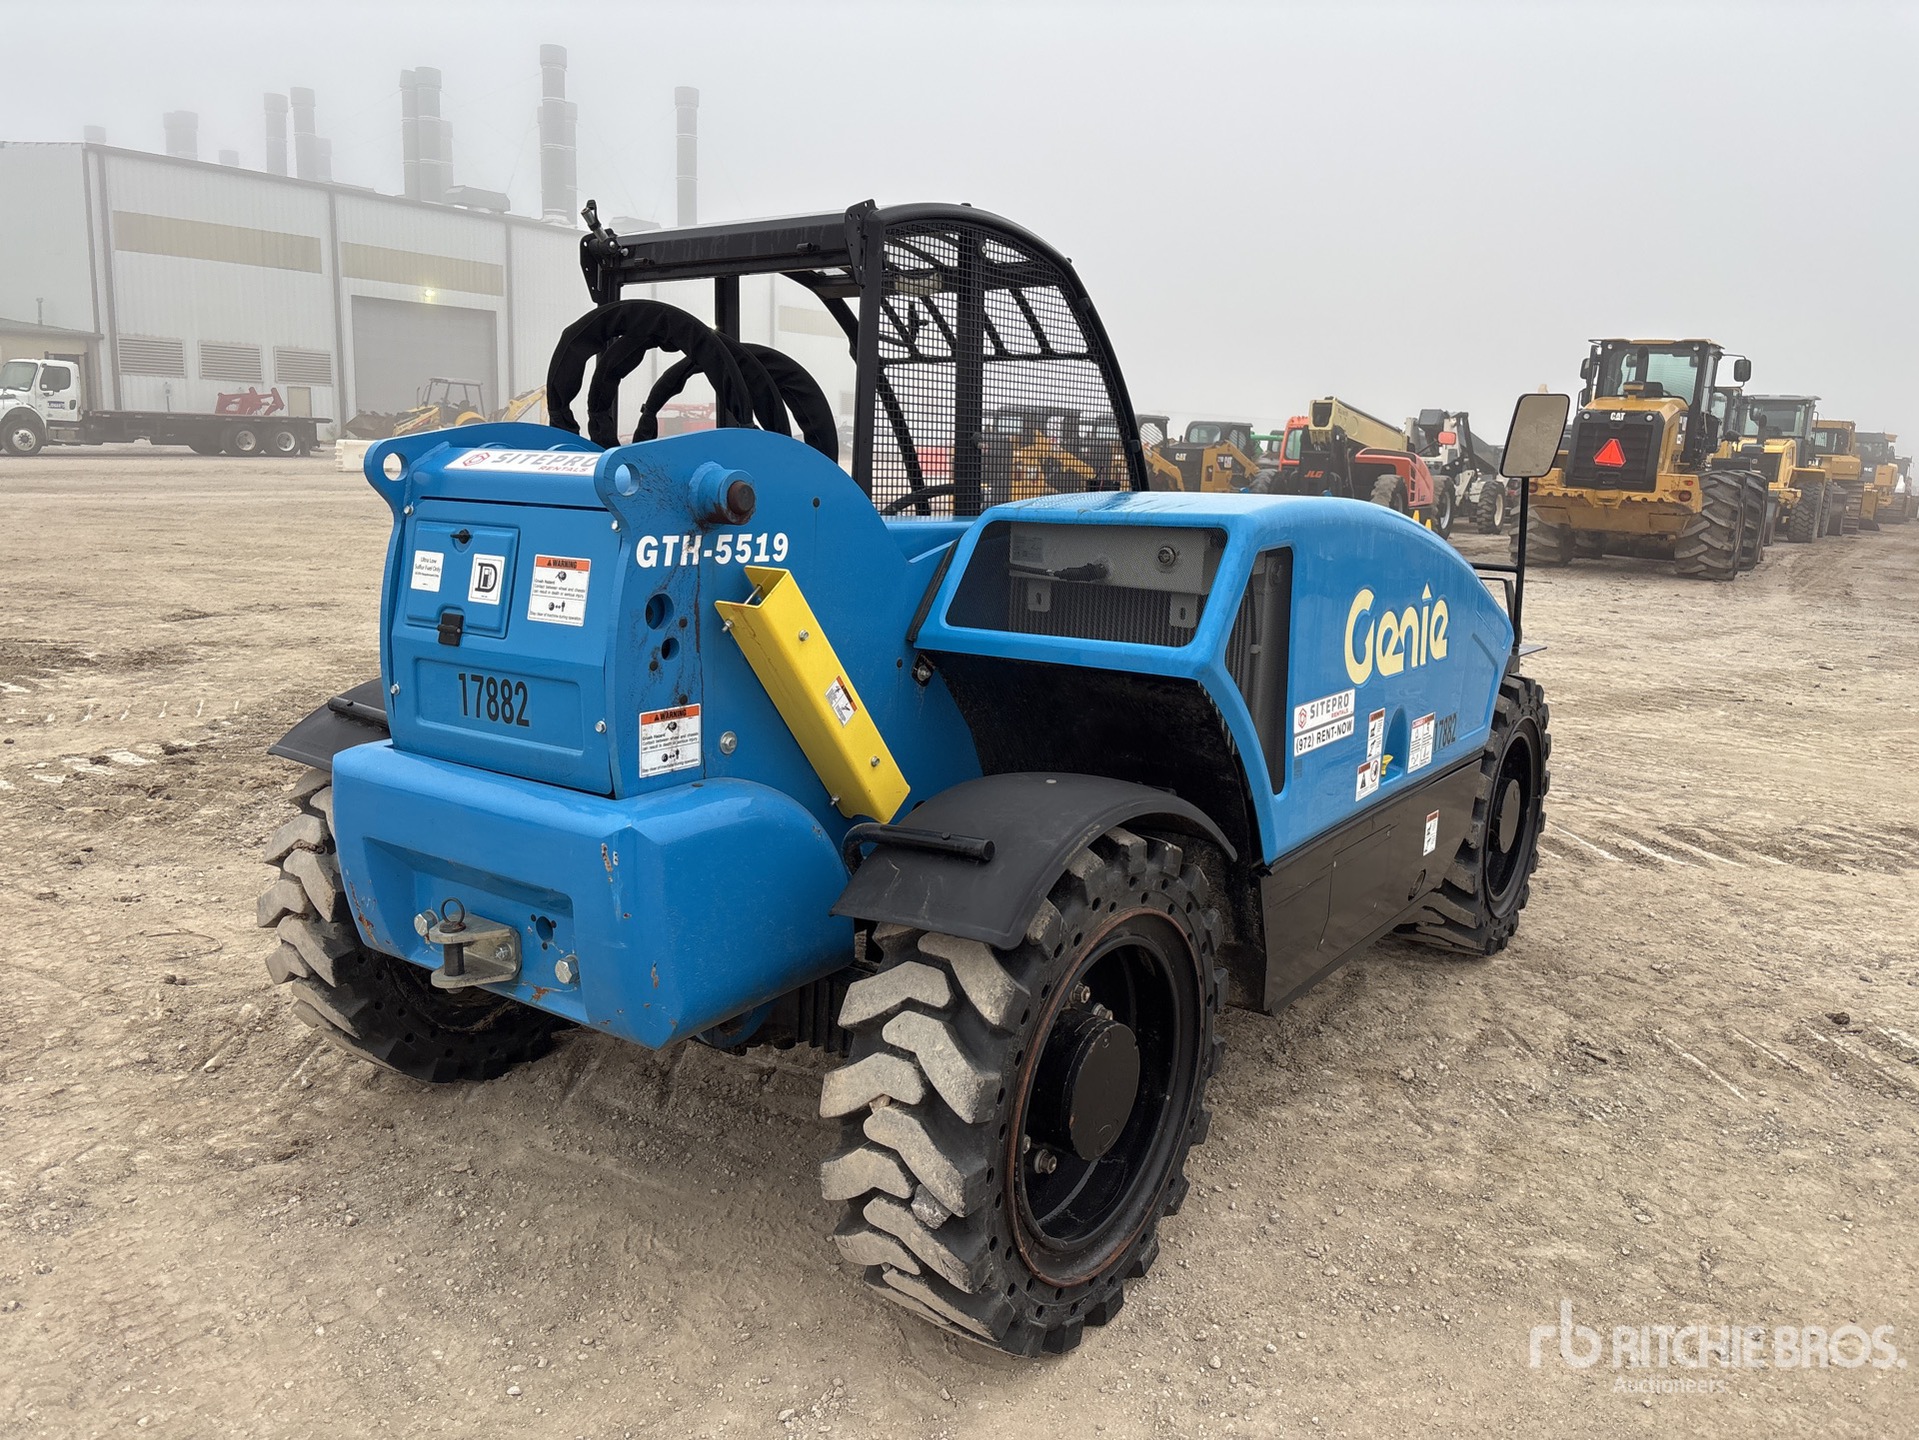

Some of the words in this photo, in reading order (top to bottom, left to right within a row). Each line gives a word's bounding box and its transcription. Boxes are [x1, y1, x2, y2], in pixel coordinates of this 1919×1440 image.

[1610, 412, 1626, 421] CAT
[491, 453, 600, 467] SITEPRO
[1175, 453, 1187, 461] CAT
[1304, 470, 1324, 478] JLG
[636, 532, 789, 568] GTH-5519
[552, 560, 577, 569] WARNING
[1344, 579, 1449, 685] Genie
[458, 673, 530, 727] 17882
[1310, 693, 1349, 720] SITEPRO
[660, 709, 686, 720] WARNING
[1331, 708, 1348, 718] RENTALS
[1296, 733, 1314, 753] (972)
[1316, 719, 1352, 744] RENT-NOW
